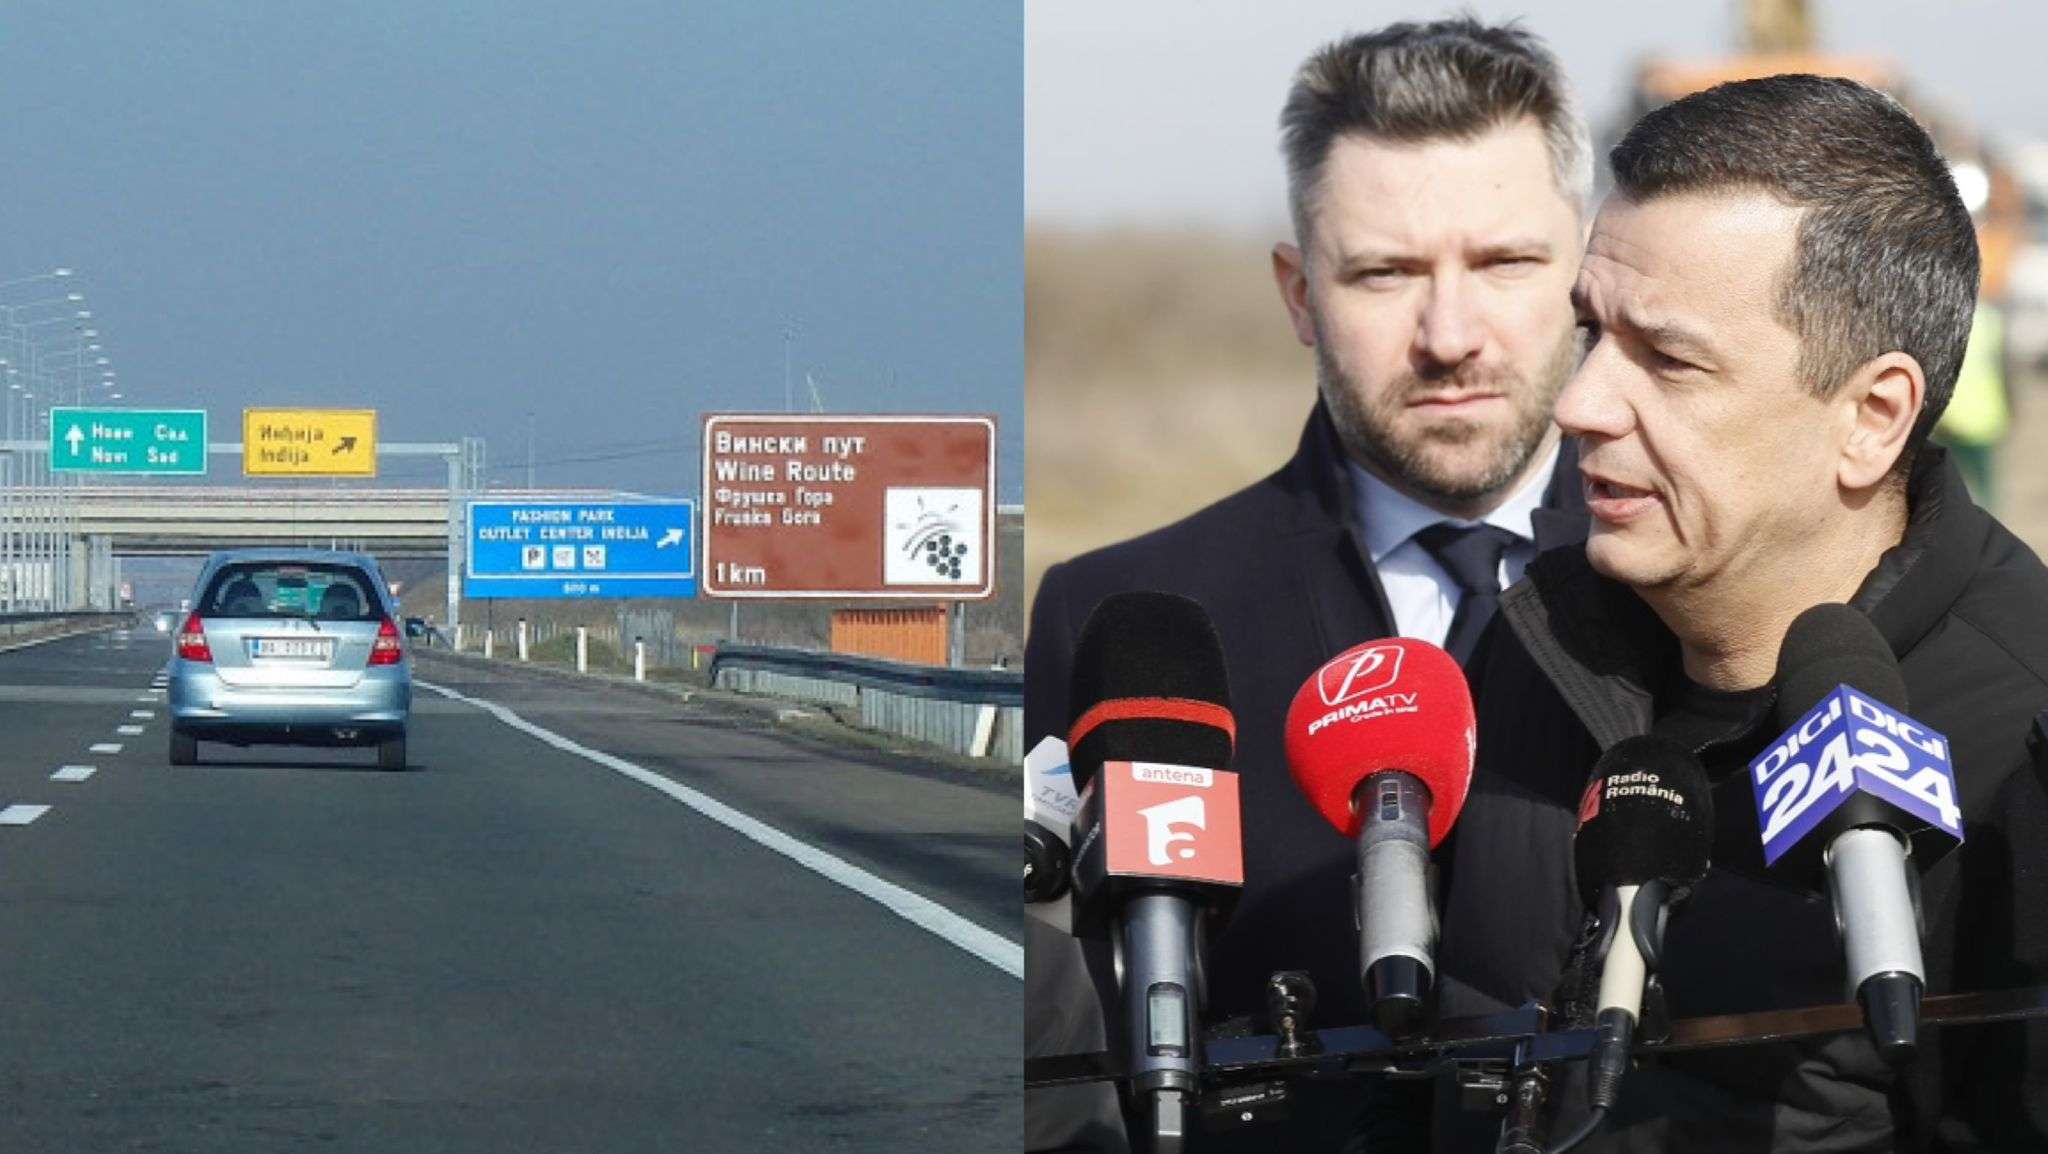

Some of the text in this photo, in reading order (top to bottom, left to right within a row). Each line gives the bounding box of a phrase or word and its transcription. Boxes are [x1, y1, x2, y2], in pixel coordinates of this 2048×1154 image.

[714, 431, 866, 458] Вински пут
[714, 461, 856, 481] Wine Route
[1755, 697, 1843, 785] DIGI
[1850, 695, 1945, 760] DIGI
[1141, 766, 1205, 784] antena
[1607, 770, 1660, 786] Radio
[1761, 732, 1854, 845] 24
[1851, 728, 1962, 829] 24
[1606, 784, 1684, 805] România
